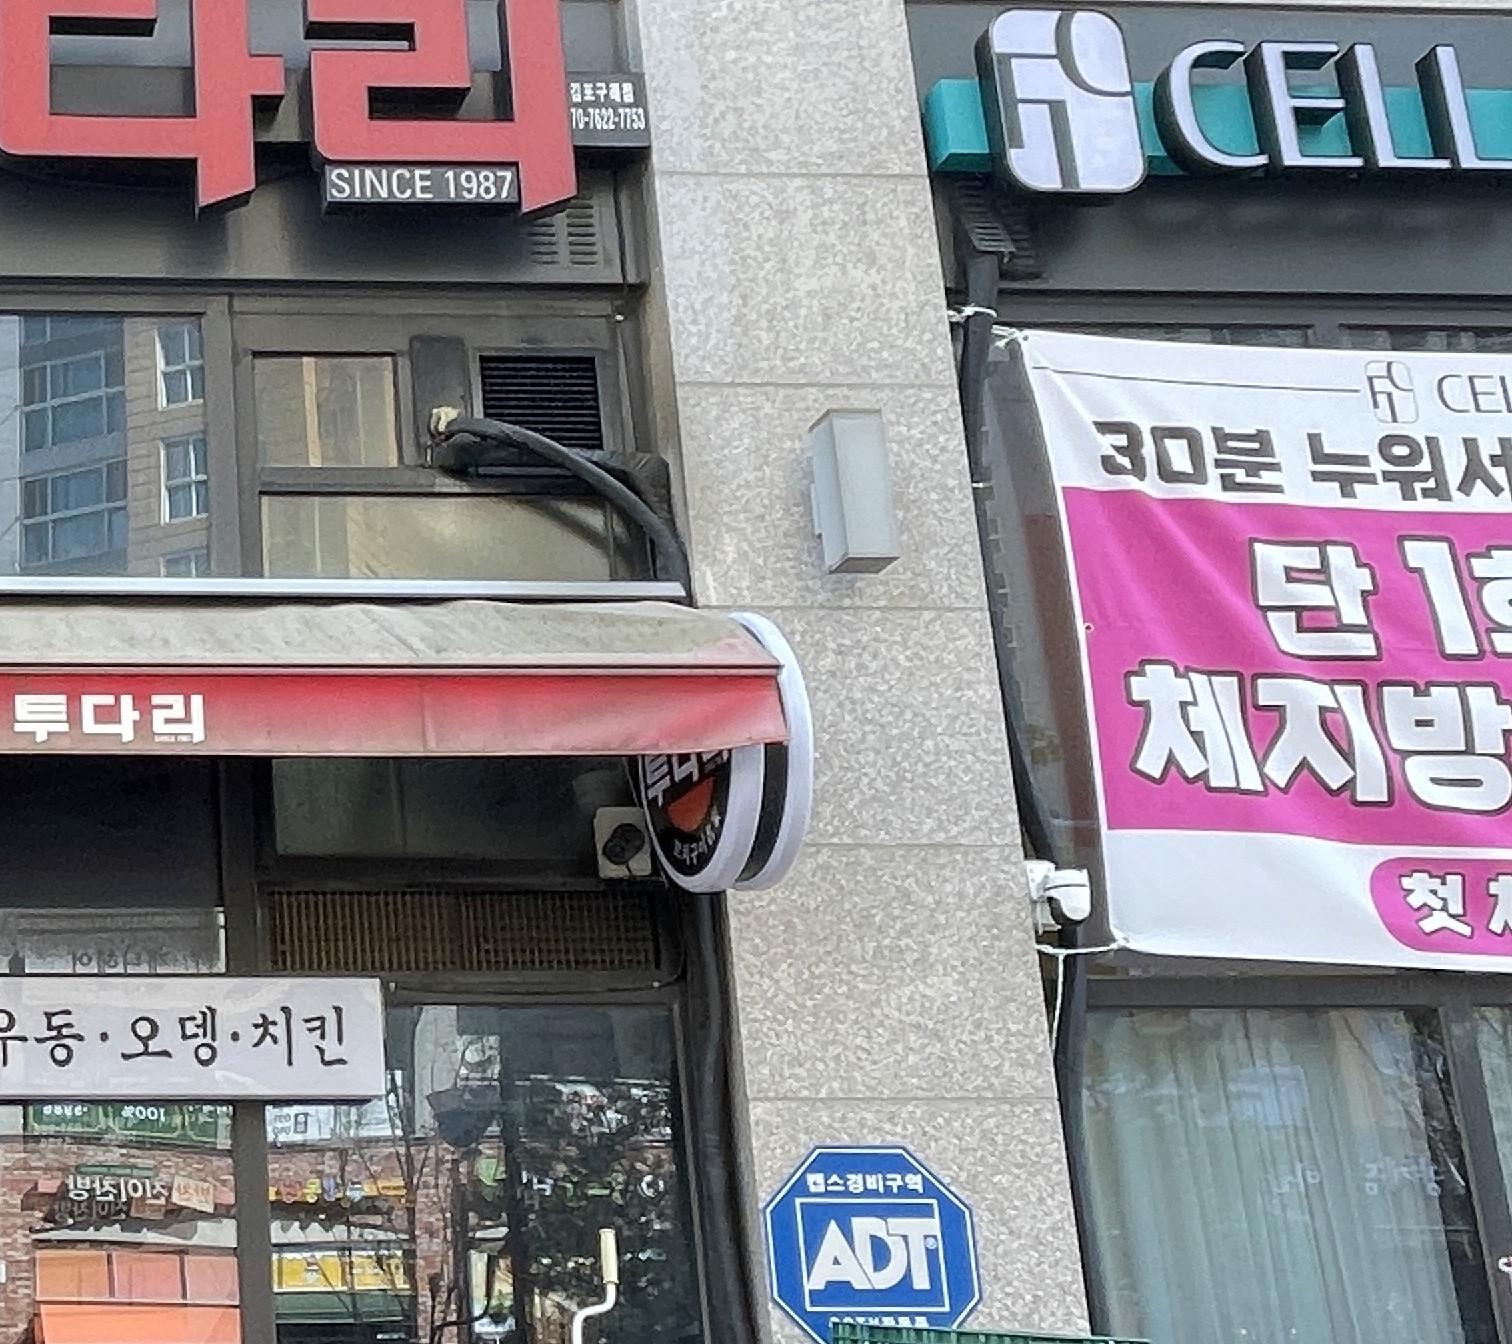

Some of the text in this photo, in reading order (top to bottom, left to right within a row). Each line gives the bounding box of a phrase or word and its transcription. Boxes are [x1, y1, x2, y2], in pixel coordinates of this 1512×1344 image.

[329, 168, 513, 200] SINCE 1987
[1091, 420, 1285, 494] 30분
[1250, 536, 1382, 660] 단
[13, 694, 206, 744] 투다리
[1124, 658, 1512, 814] 체지방
[1399, 870, 1473, 938] 첫
[806, 1172, 925, 1194] 캡스경비구역
[807, 1216, 938, 1290] ADT
